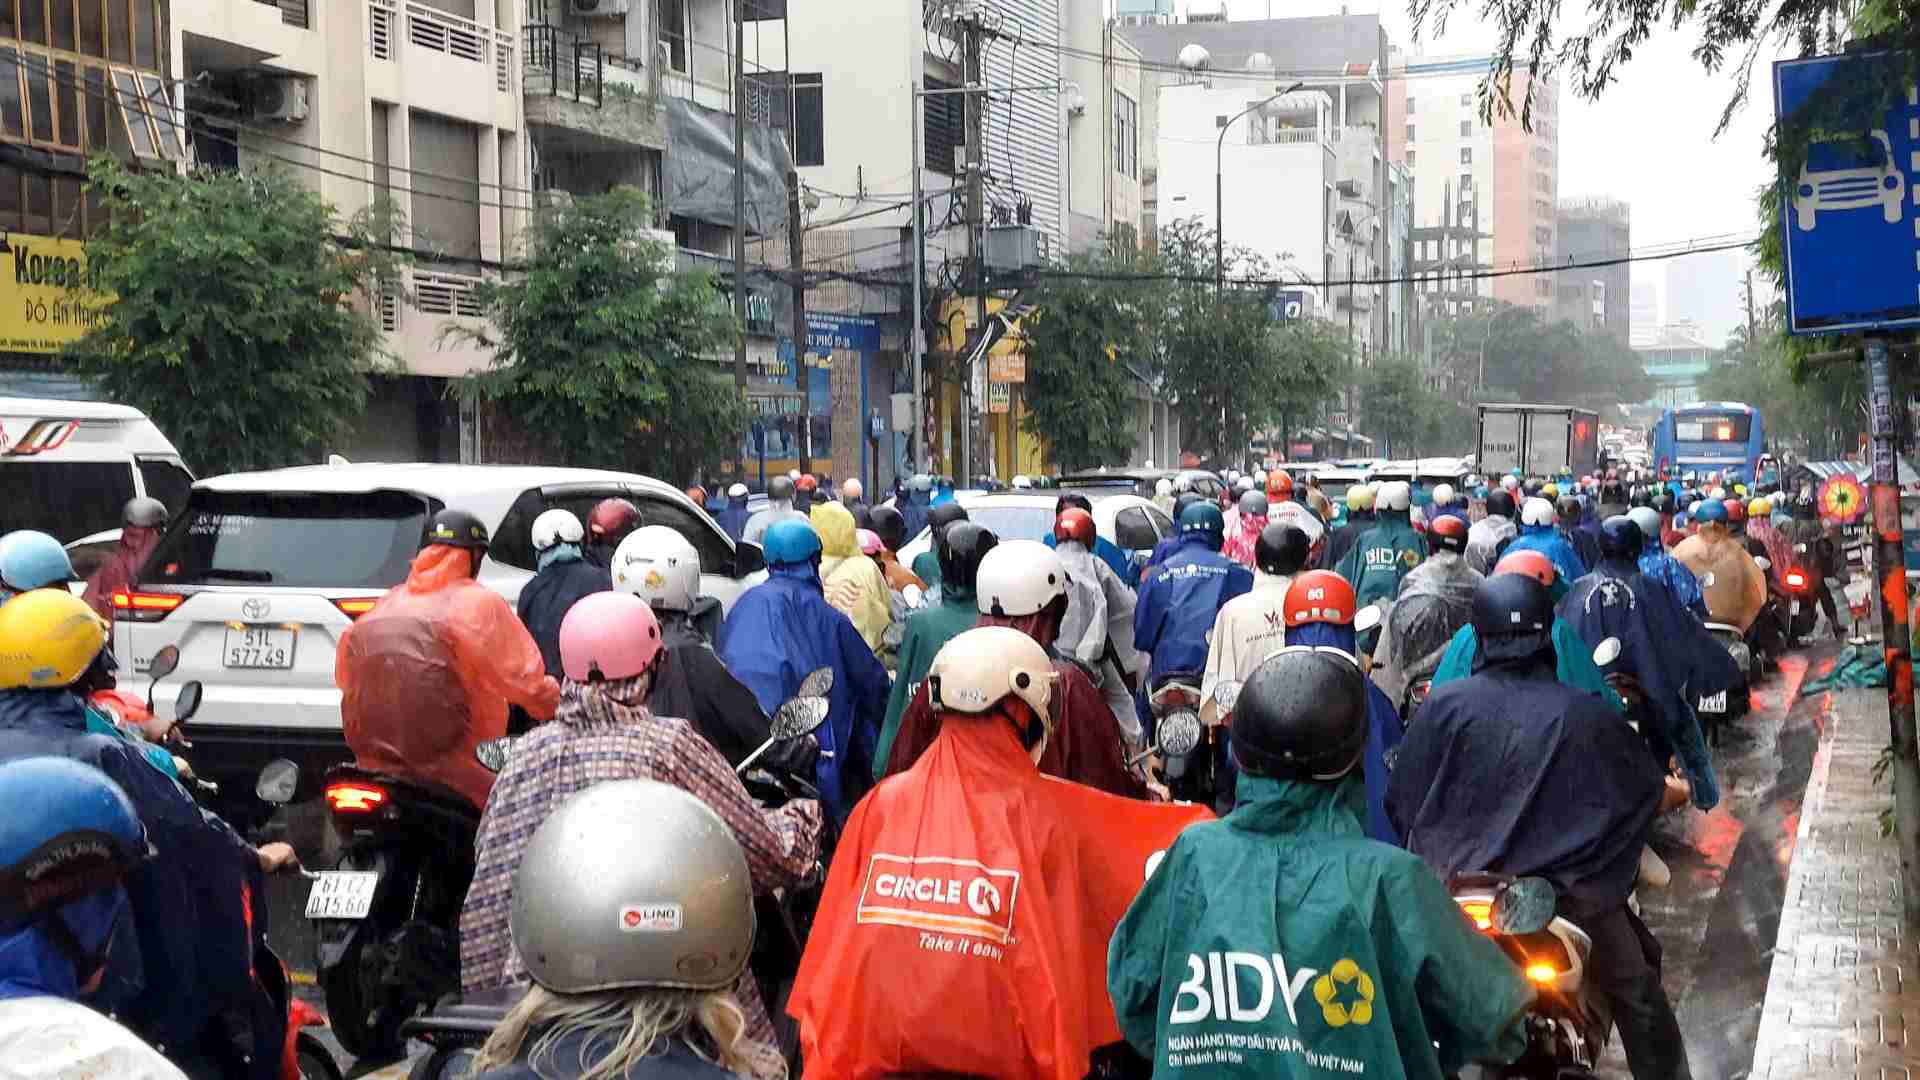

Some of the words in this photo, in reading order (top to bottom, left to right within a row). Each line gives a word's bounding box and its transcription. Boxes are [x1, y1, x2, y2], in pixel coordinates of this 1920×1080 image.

[245, 629, 273, 647] 51L
[231, 648, 285, 666] 577.49
[875, 873, 963, 905] CIRCLE
[967, 876, 1001, 916] K
[643, 909, 676, 920] LINO
[919, 932, 954, 952] Take
[1340, 1058, 1364, 1074] NAM
